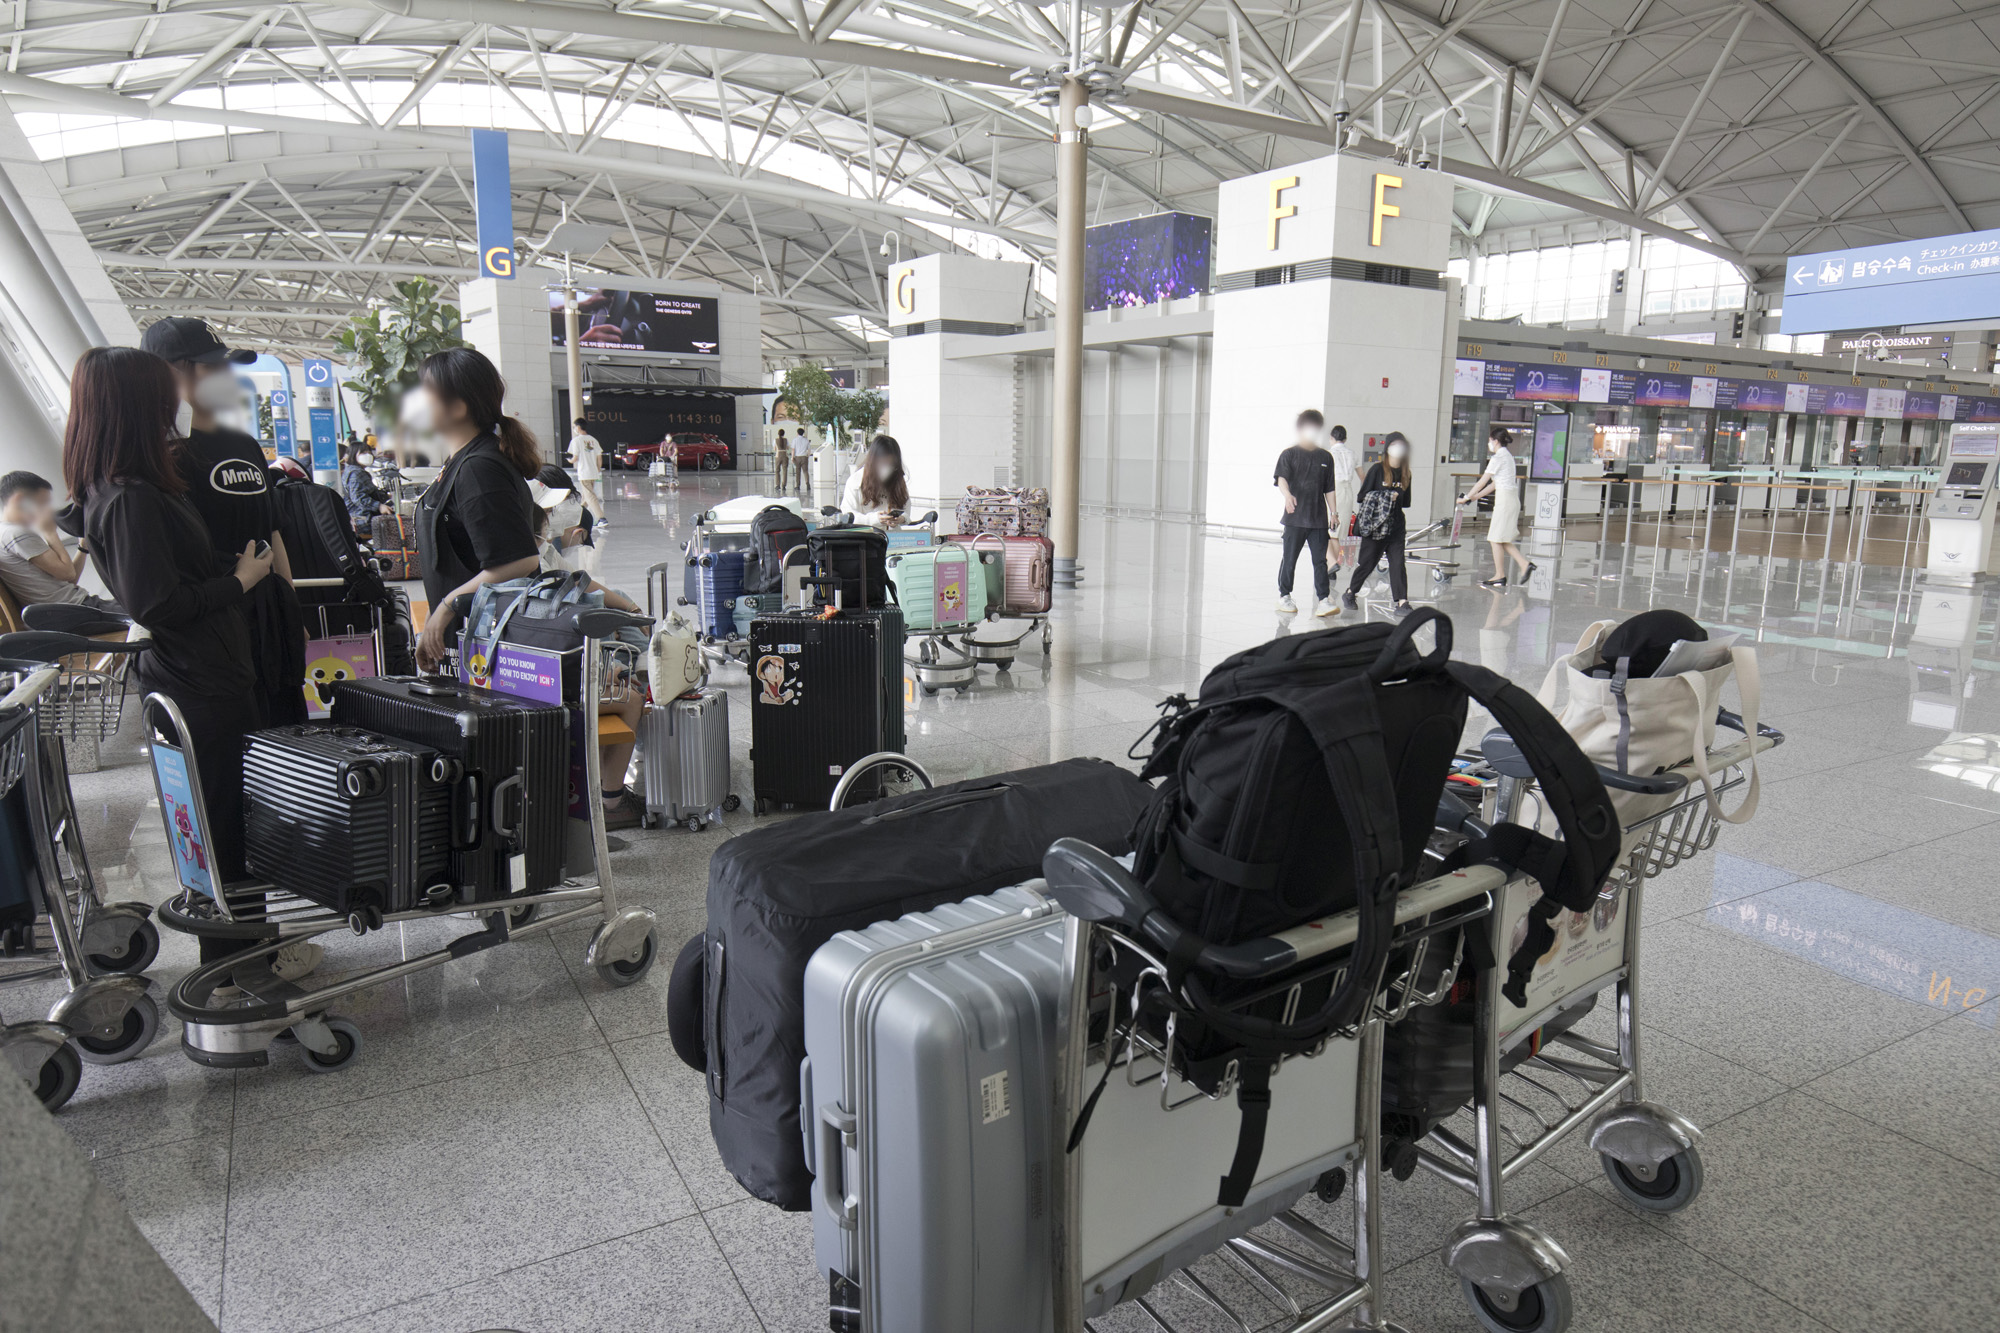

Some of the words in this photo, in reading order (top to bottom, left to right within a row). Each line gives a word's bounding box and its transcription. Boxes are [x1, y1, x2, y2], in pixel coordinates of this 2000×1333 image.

[1267, 176, 1300, 251] F
[1368, 173, 1402, 246] F
[1920, 239, 2000, 260] チェックインカウ
[485, 246, 512, 276] G
[1852, 256, 1912, 278] 탑승수속
[1917, 260, 1965, 276] Check-in
[895, 268, 915, 314] G
[655, 300, 671, 308] BORN
[681, 302, 701, 310] CREATE
[1842, 340, 1871, 350] PARIS
[1872, 336, 1932, 348] CROISSANT
[1466, 344, 1482, 357] F19
[1553, 352, 1567, 363] F20
[1596, 355, 1609, 366] F21
[1668, 361, 1681, 372] F22
[1705, 364, 1717, 375] F23
[1527, 370, 1544, 389] 20
[1767, 369, 1778, 379] F24
[1798, 372, 1809, 382] F25
[1852, 376, 1862, 386] F26
[1879, 379, 1889, 388] F27
[1646, 379, 1661, 397] 20
[1747, 385, 1760, 402] 20
[584, 411, 628, 423] EOUL
[668, 413, 722, 425] 11:43:10
[221, 468, 263, 486] Mmlg
[1541, 505, 1551, 516] kg
[500, 655, 507, 664] DO
[507, 656, 519, 667] YOU
[519, 658, 536, 671] KNOW
[439, 664, 453, 677] ALL
[500, 669, 512, 678] HOW
[512, 670, 520, 679] TO
[520, 672, 538, 683] ENJOY
[539, 674, 550, 685] ICN
